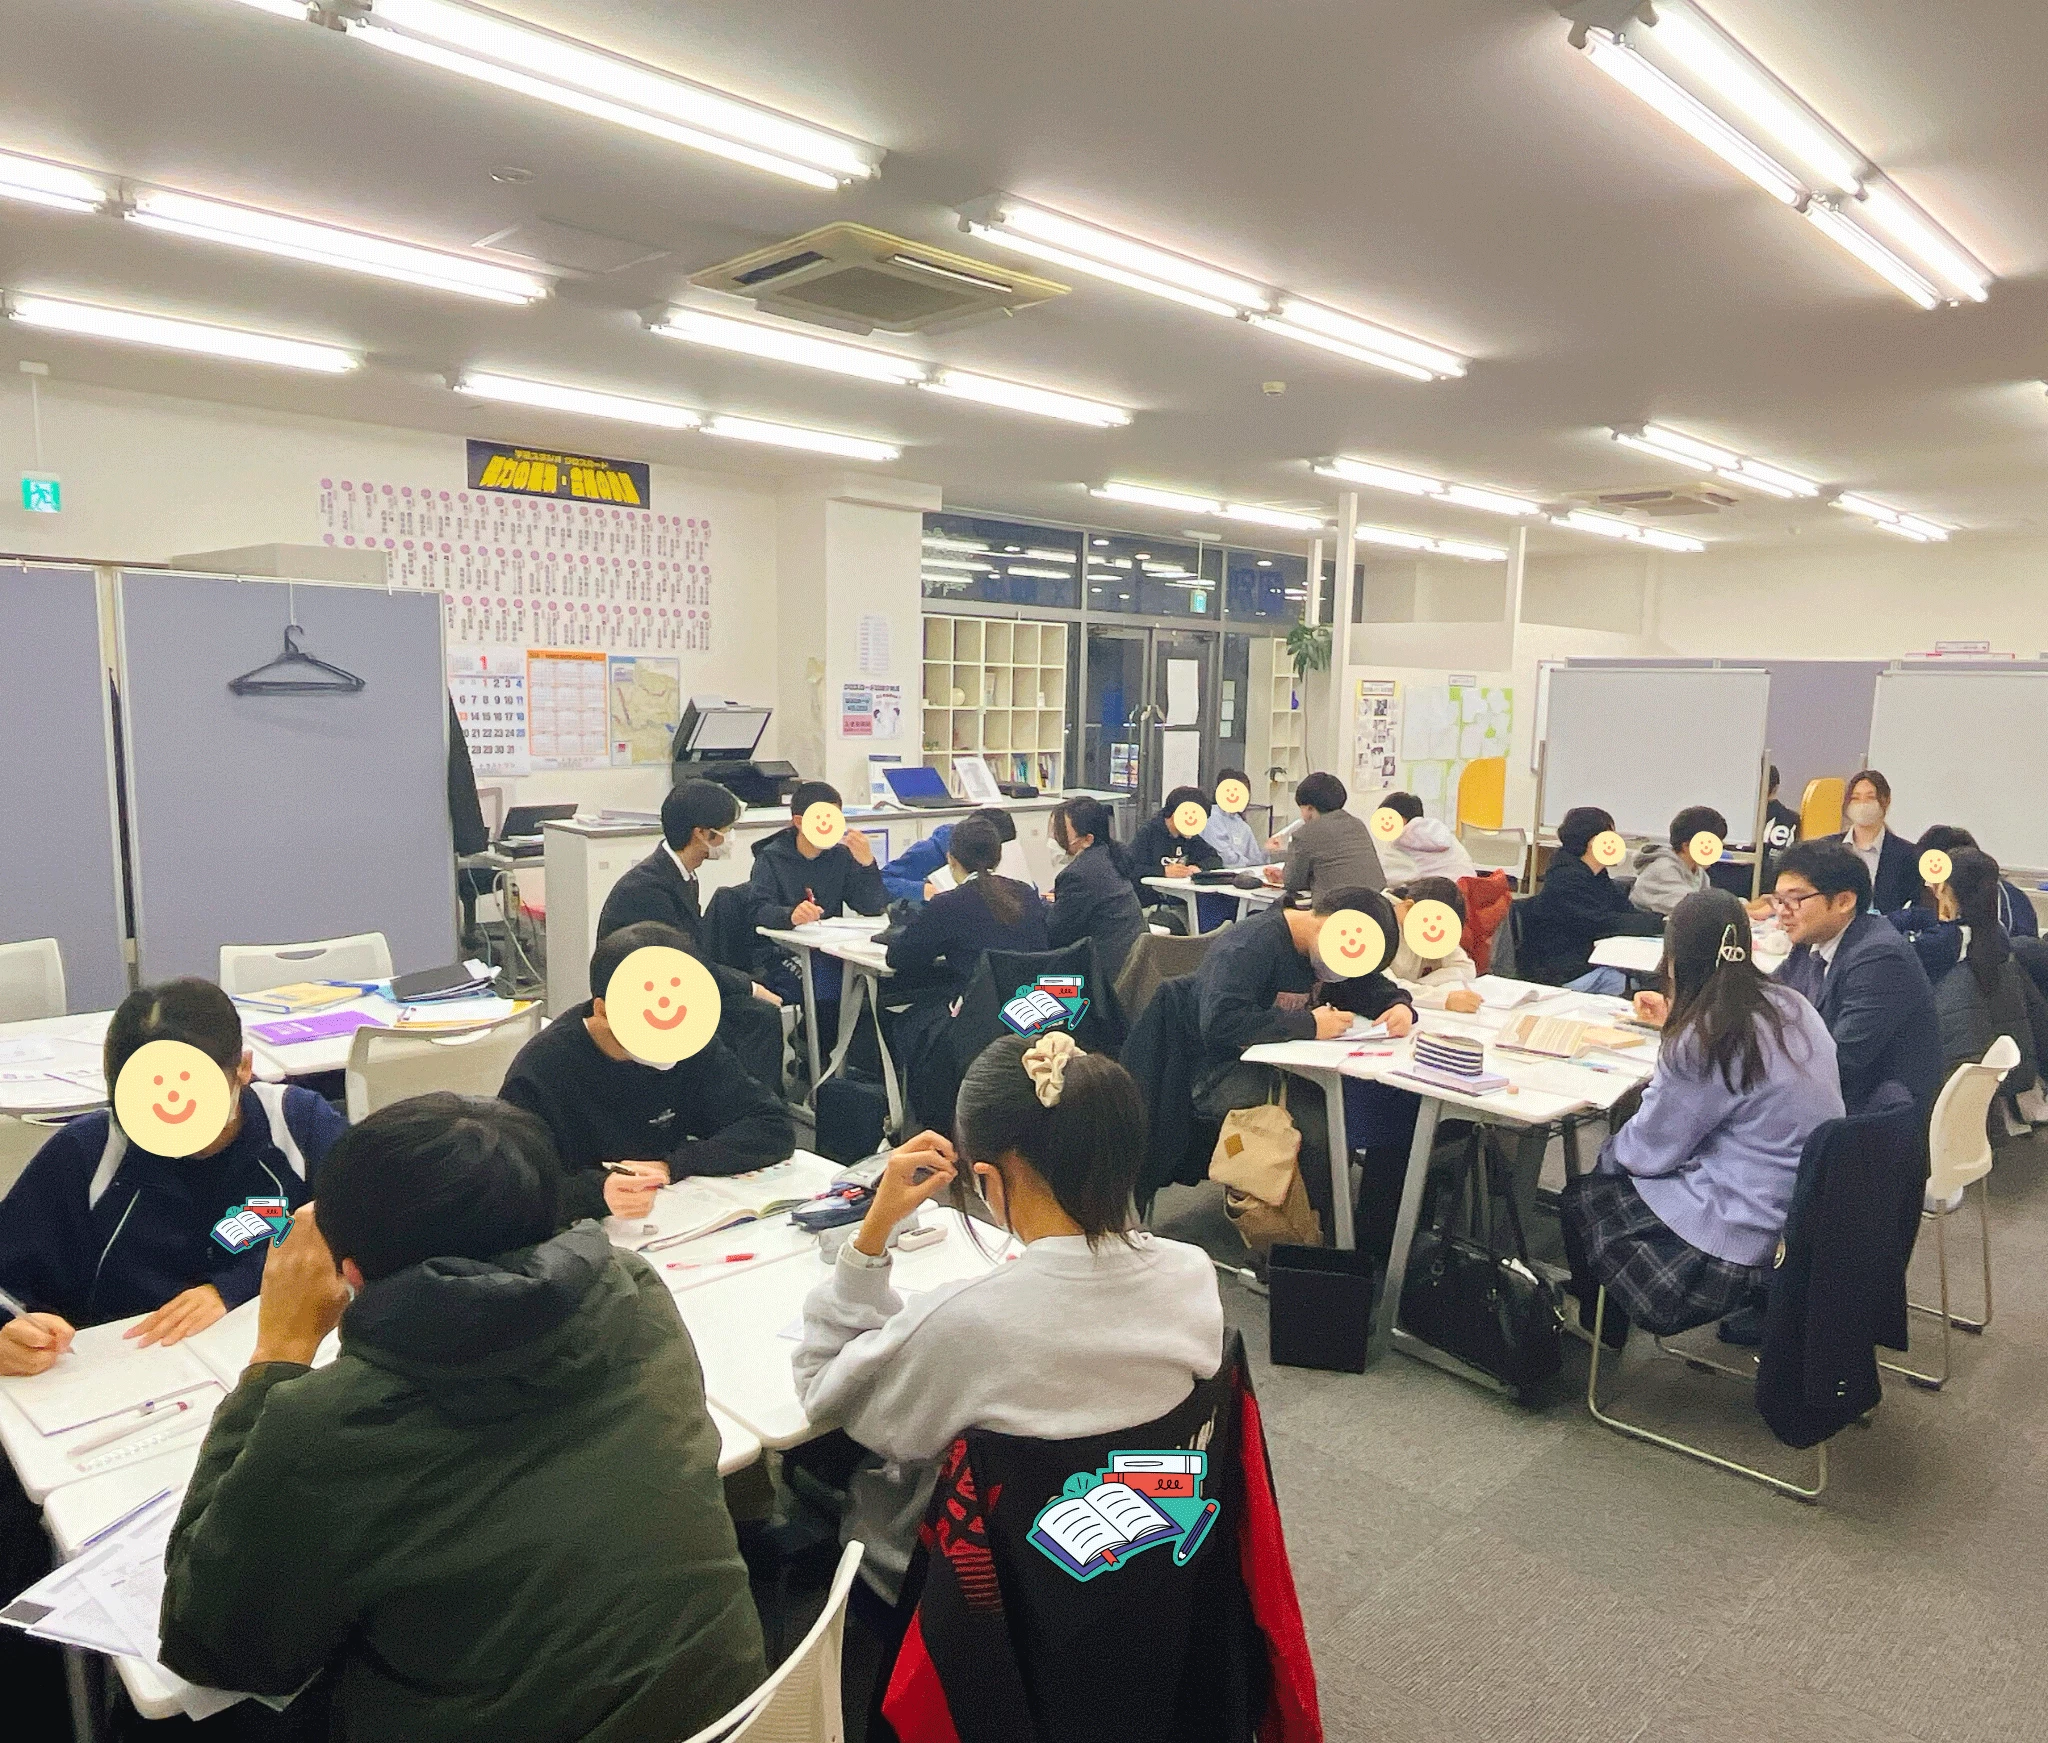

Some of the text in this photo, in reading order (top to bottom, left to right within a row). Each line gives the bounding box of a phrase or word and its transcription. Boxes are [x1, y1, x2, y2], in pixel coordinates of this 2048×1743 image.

[494, 679, 500, 688] 2
[516, 680, 522, 688] 4
[471, 695, 477, 704] 7
[494, 695, 500, 704] 9
[471, 712, 480, 721] 14
[482, 712, 491, 721] 15
[505, 712, 513, 721] 17
[471, 729, 480, 738] 21
[482, 729, 492, 738] 22
[505, 729, 515, 738] 24
